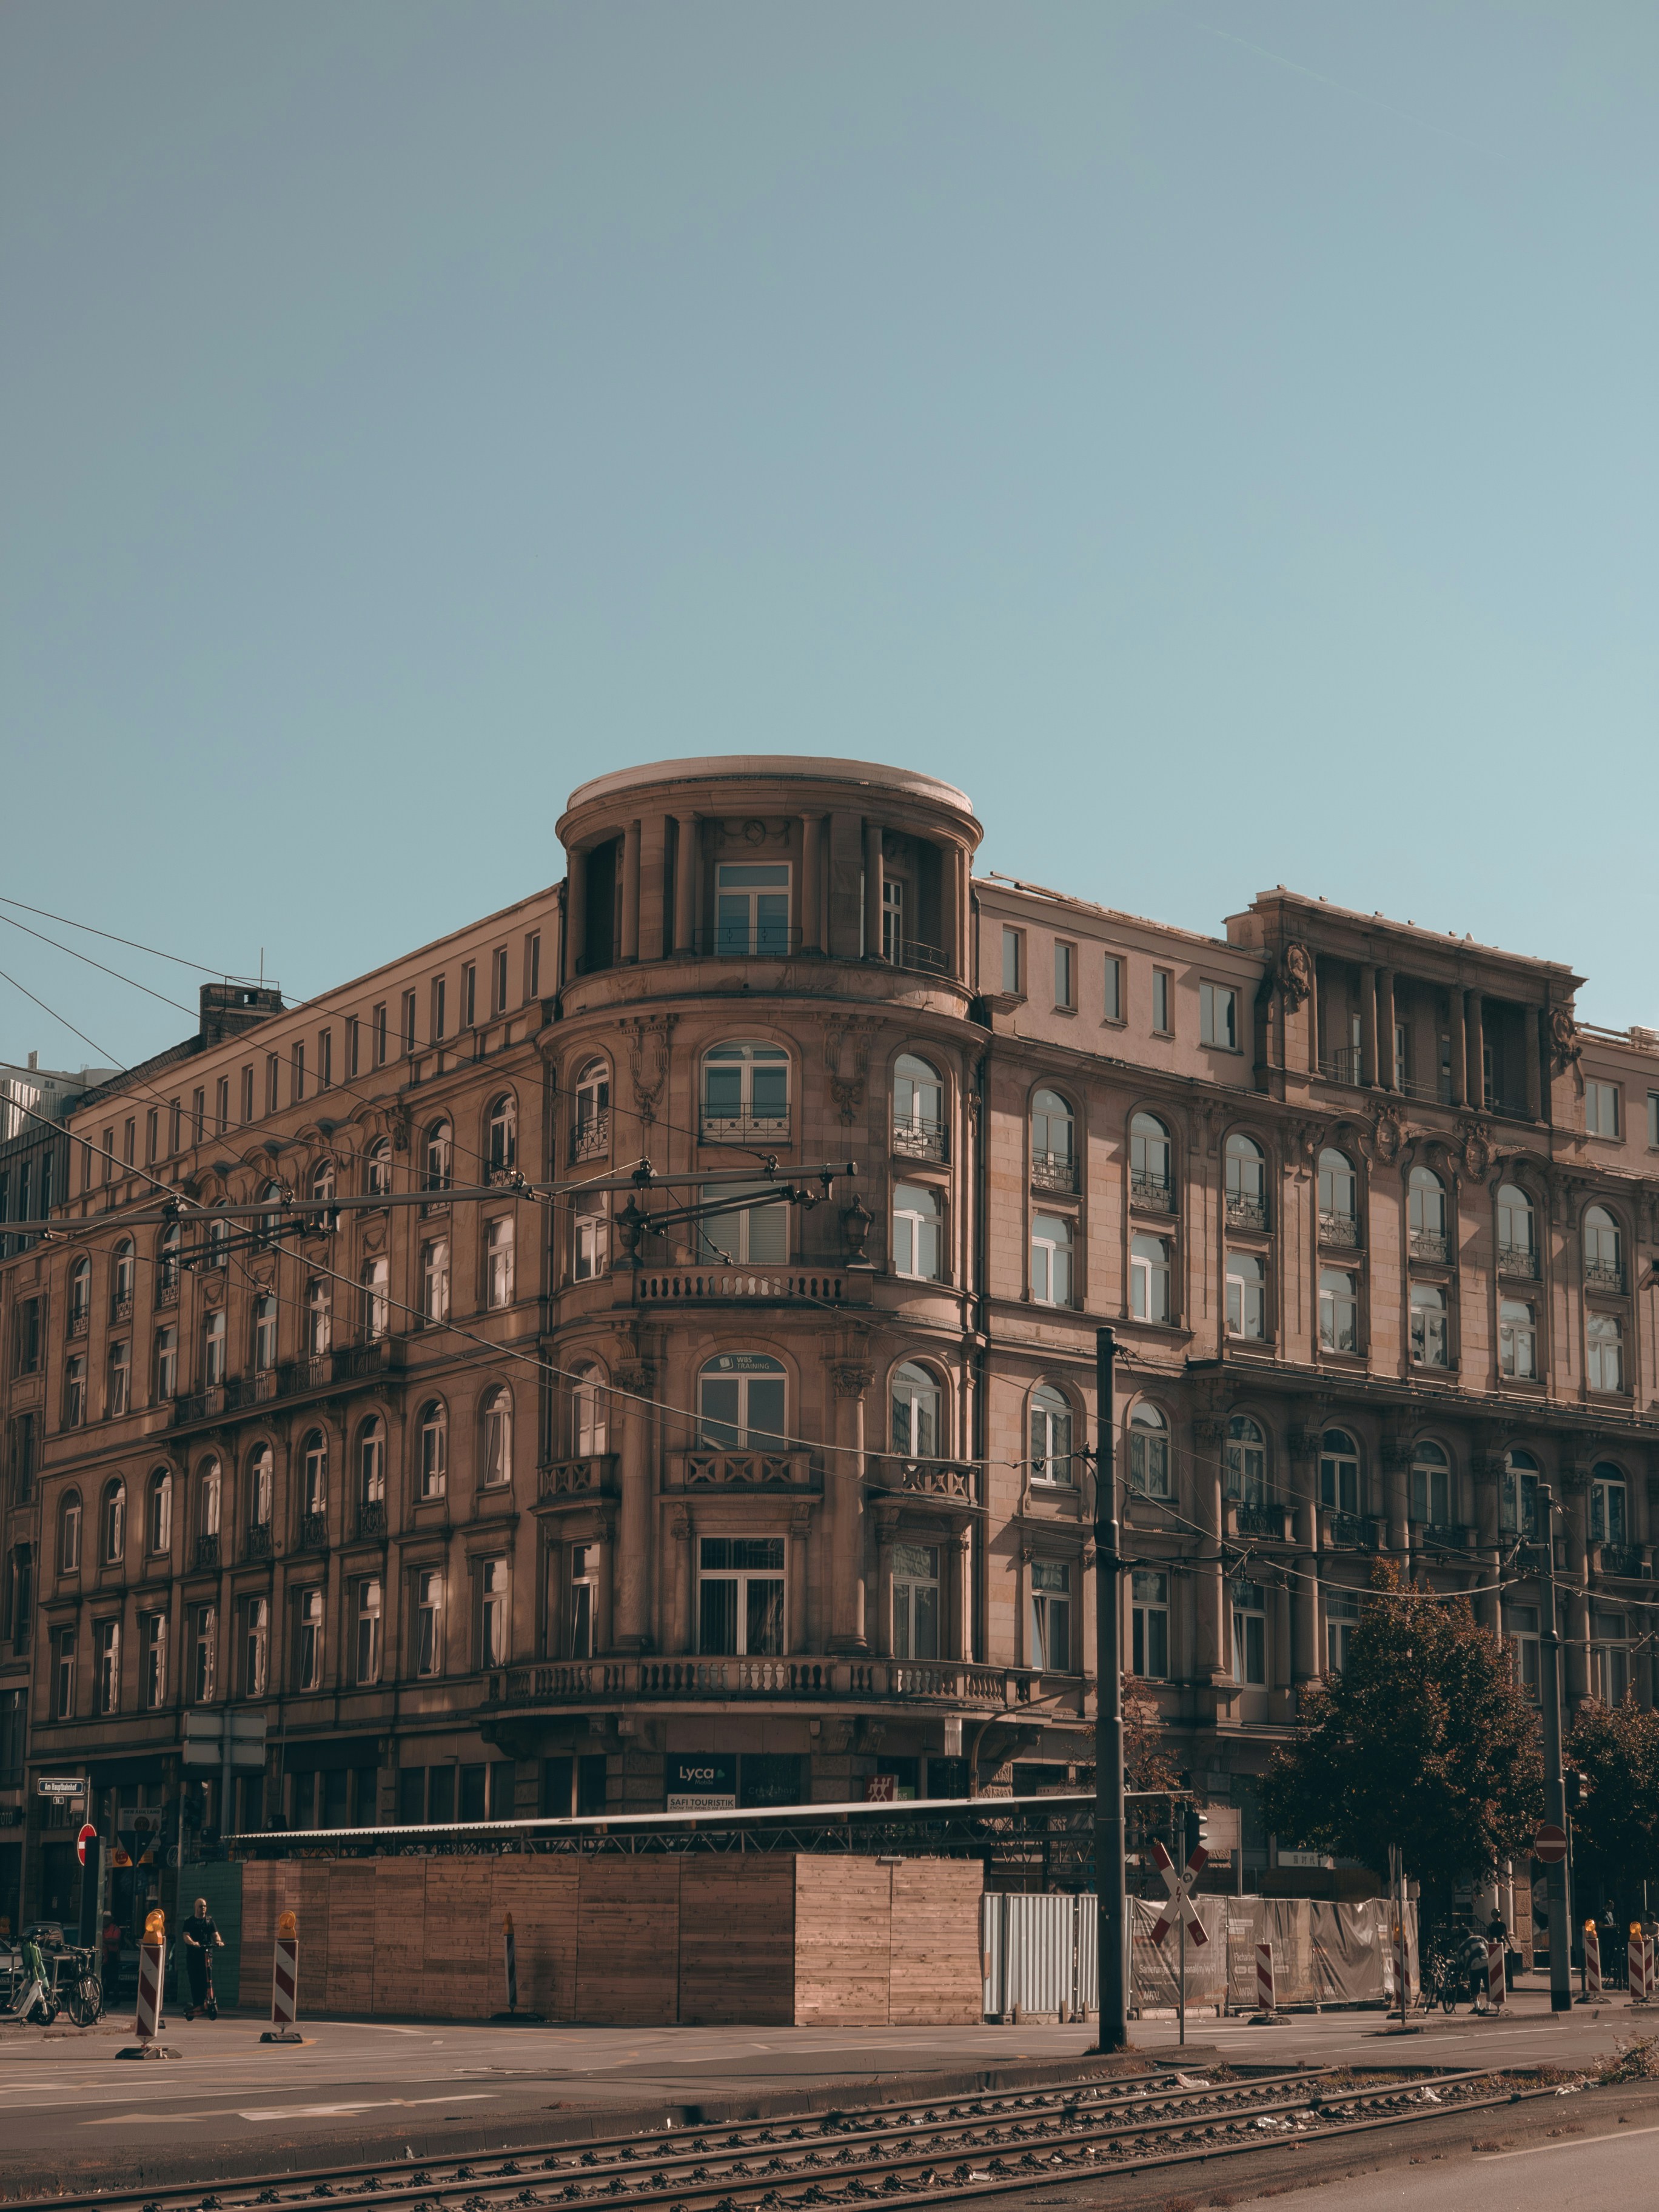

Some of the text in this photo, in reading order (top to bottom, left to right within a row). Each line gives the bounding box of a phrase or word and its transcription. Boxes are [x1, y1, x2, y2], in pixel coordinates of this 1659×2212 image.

[679, 1765, 714, 1781] Lyca
[52, 1783, 77, 1792] Hauptbahnhof
[0, 1812, 13, 1825] OTO
